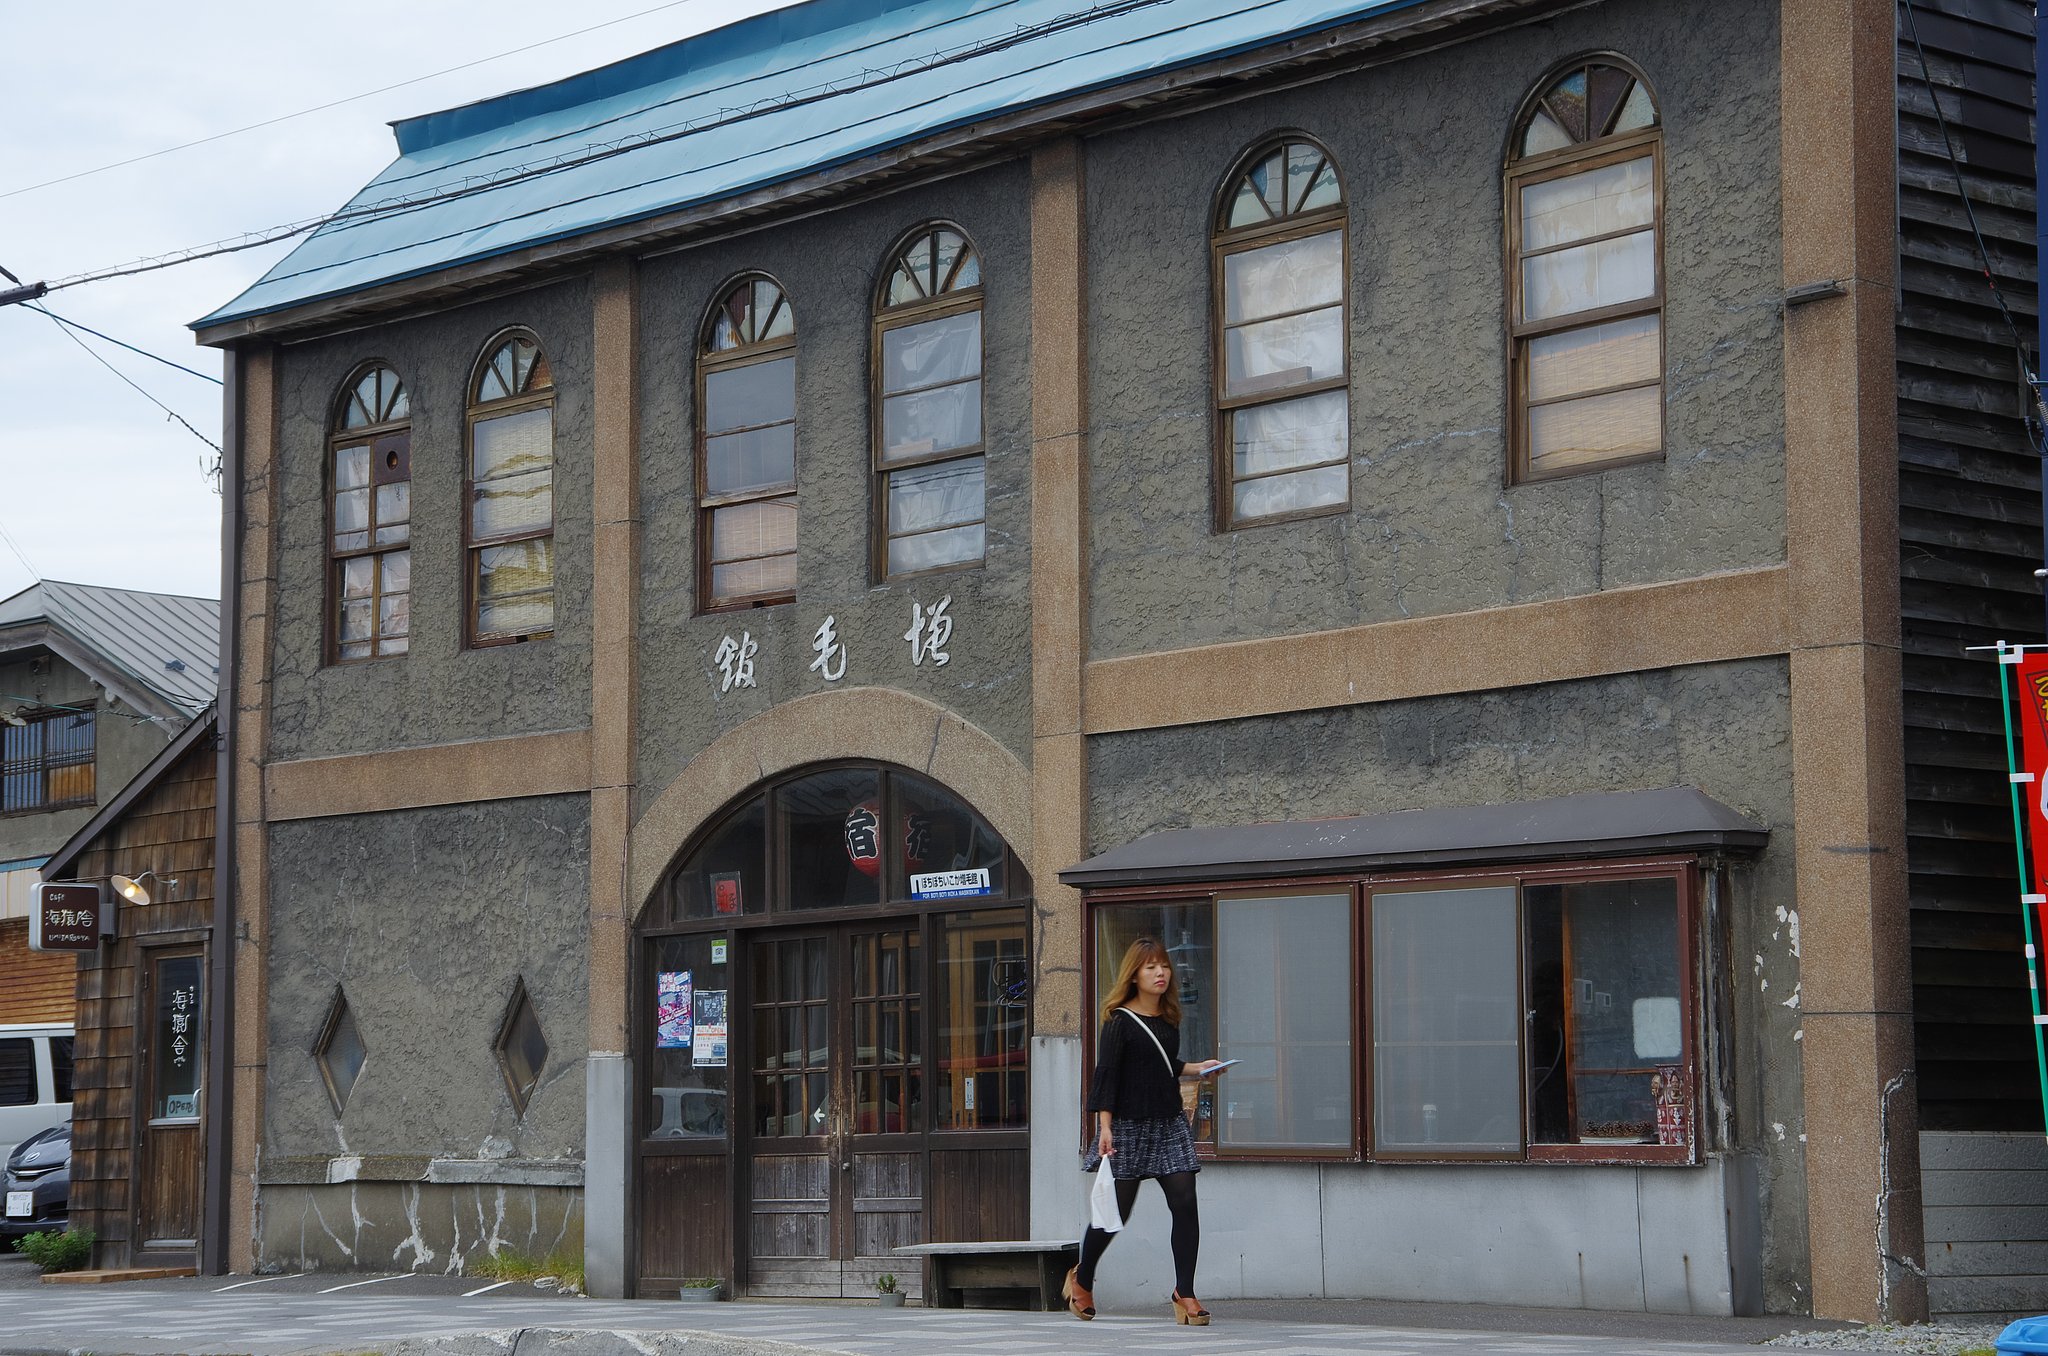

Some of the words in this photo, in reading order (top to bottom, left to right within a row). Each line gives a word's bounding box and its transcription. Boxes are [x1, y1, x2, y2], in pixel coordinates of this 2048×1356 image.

[845, 807, 878, 861] 宿
[921, 872, 979, 888] ぼちぼちいこか増毛館
[169, 1100, 194, 1113] OPEN
